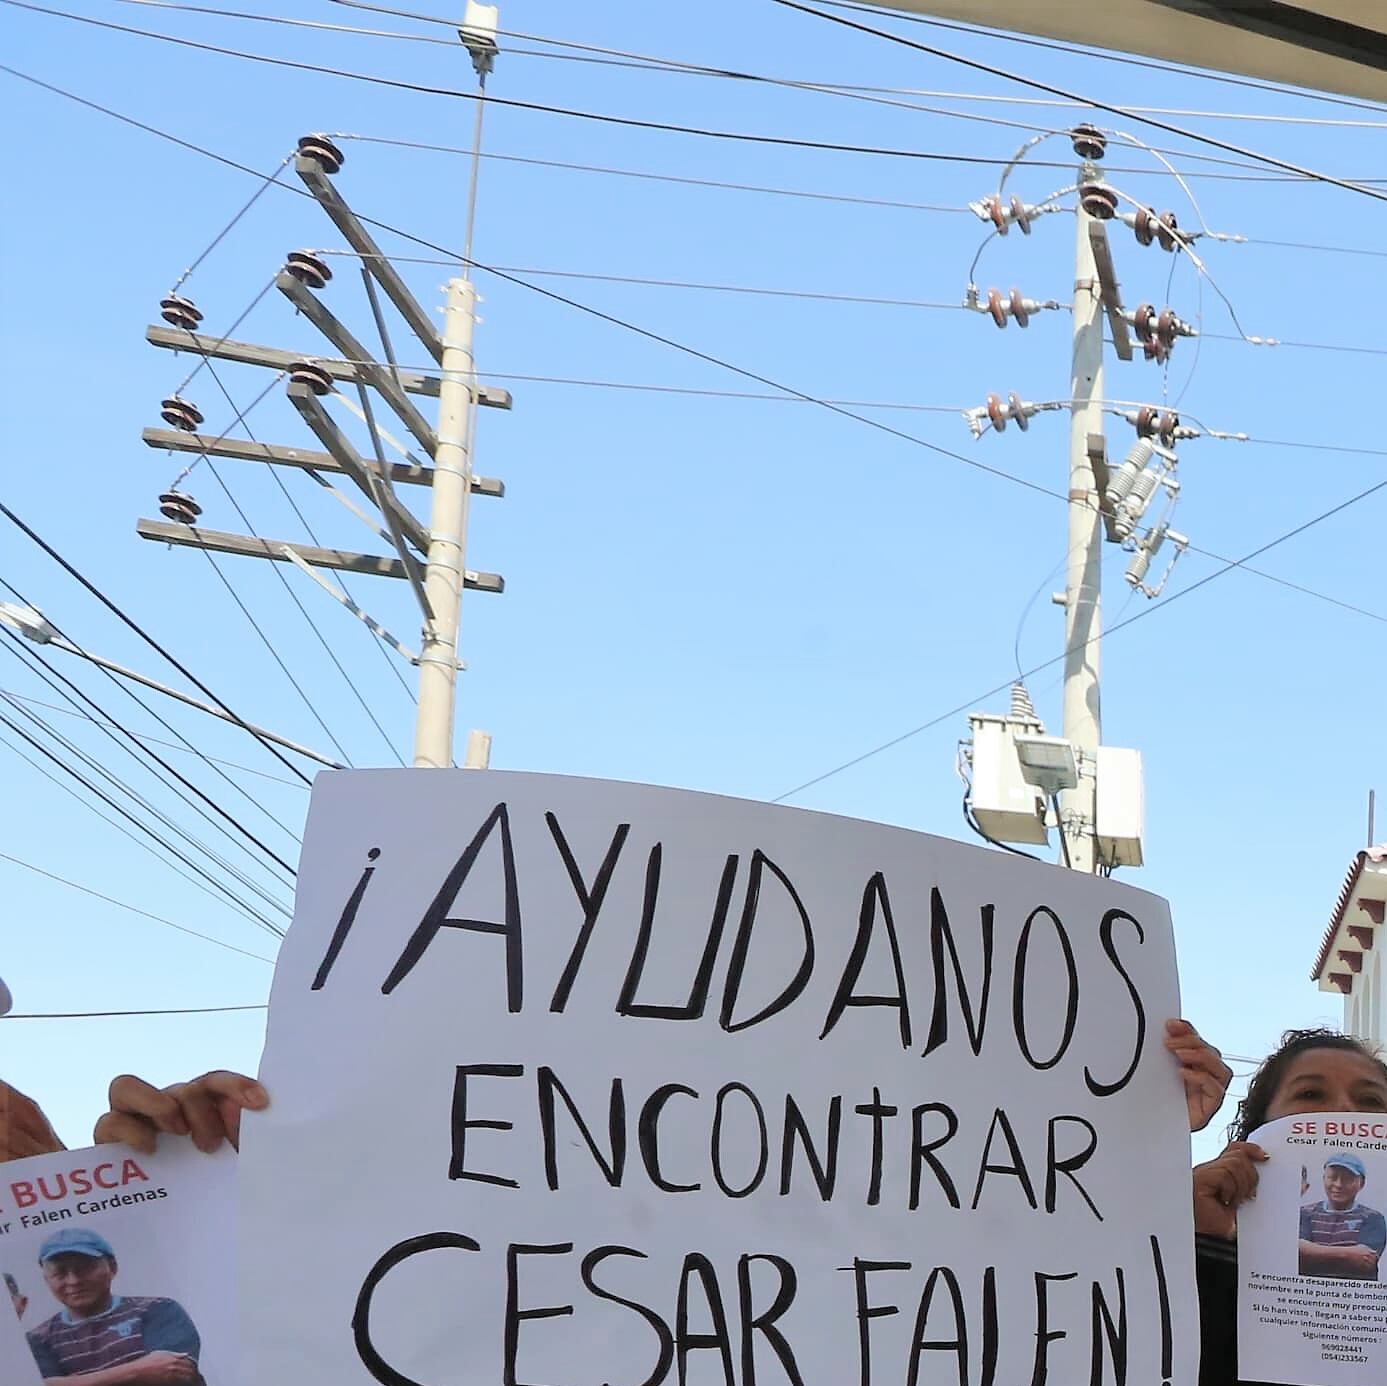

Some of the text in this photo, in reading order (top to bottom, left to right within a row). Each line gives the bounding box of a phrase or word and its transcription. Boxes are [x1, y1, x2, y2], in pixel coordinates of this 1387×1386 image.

[449, 1065, 1103, 1221] ENCONTRAR
[1286, 1136, 1318, 1145] Cesar
[1323, 1138, 1353, 1148] Falen
[1291, 1122, 1317, 1135] SE
[10, 1160, 150, 1208] BUSCA
[20, 1188, 168, 1228] Falen Cardenas
